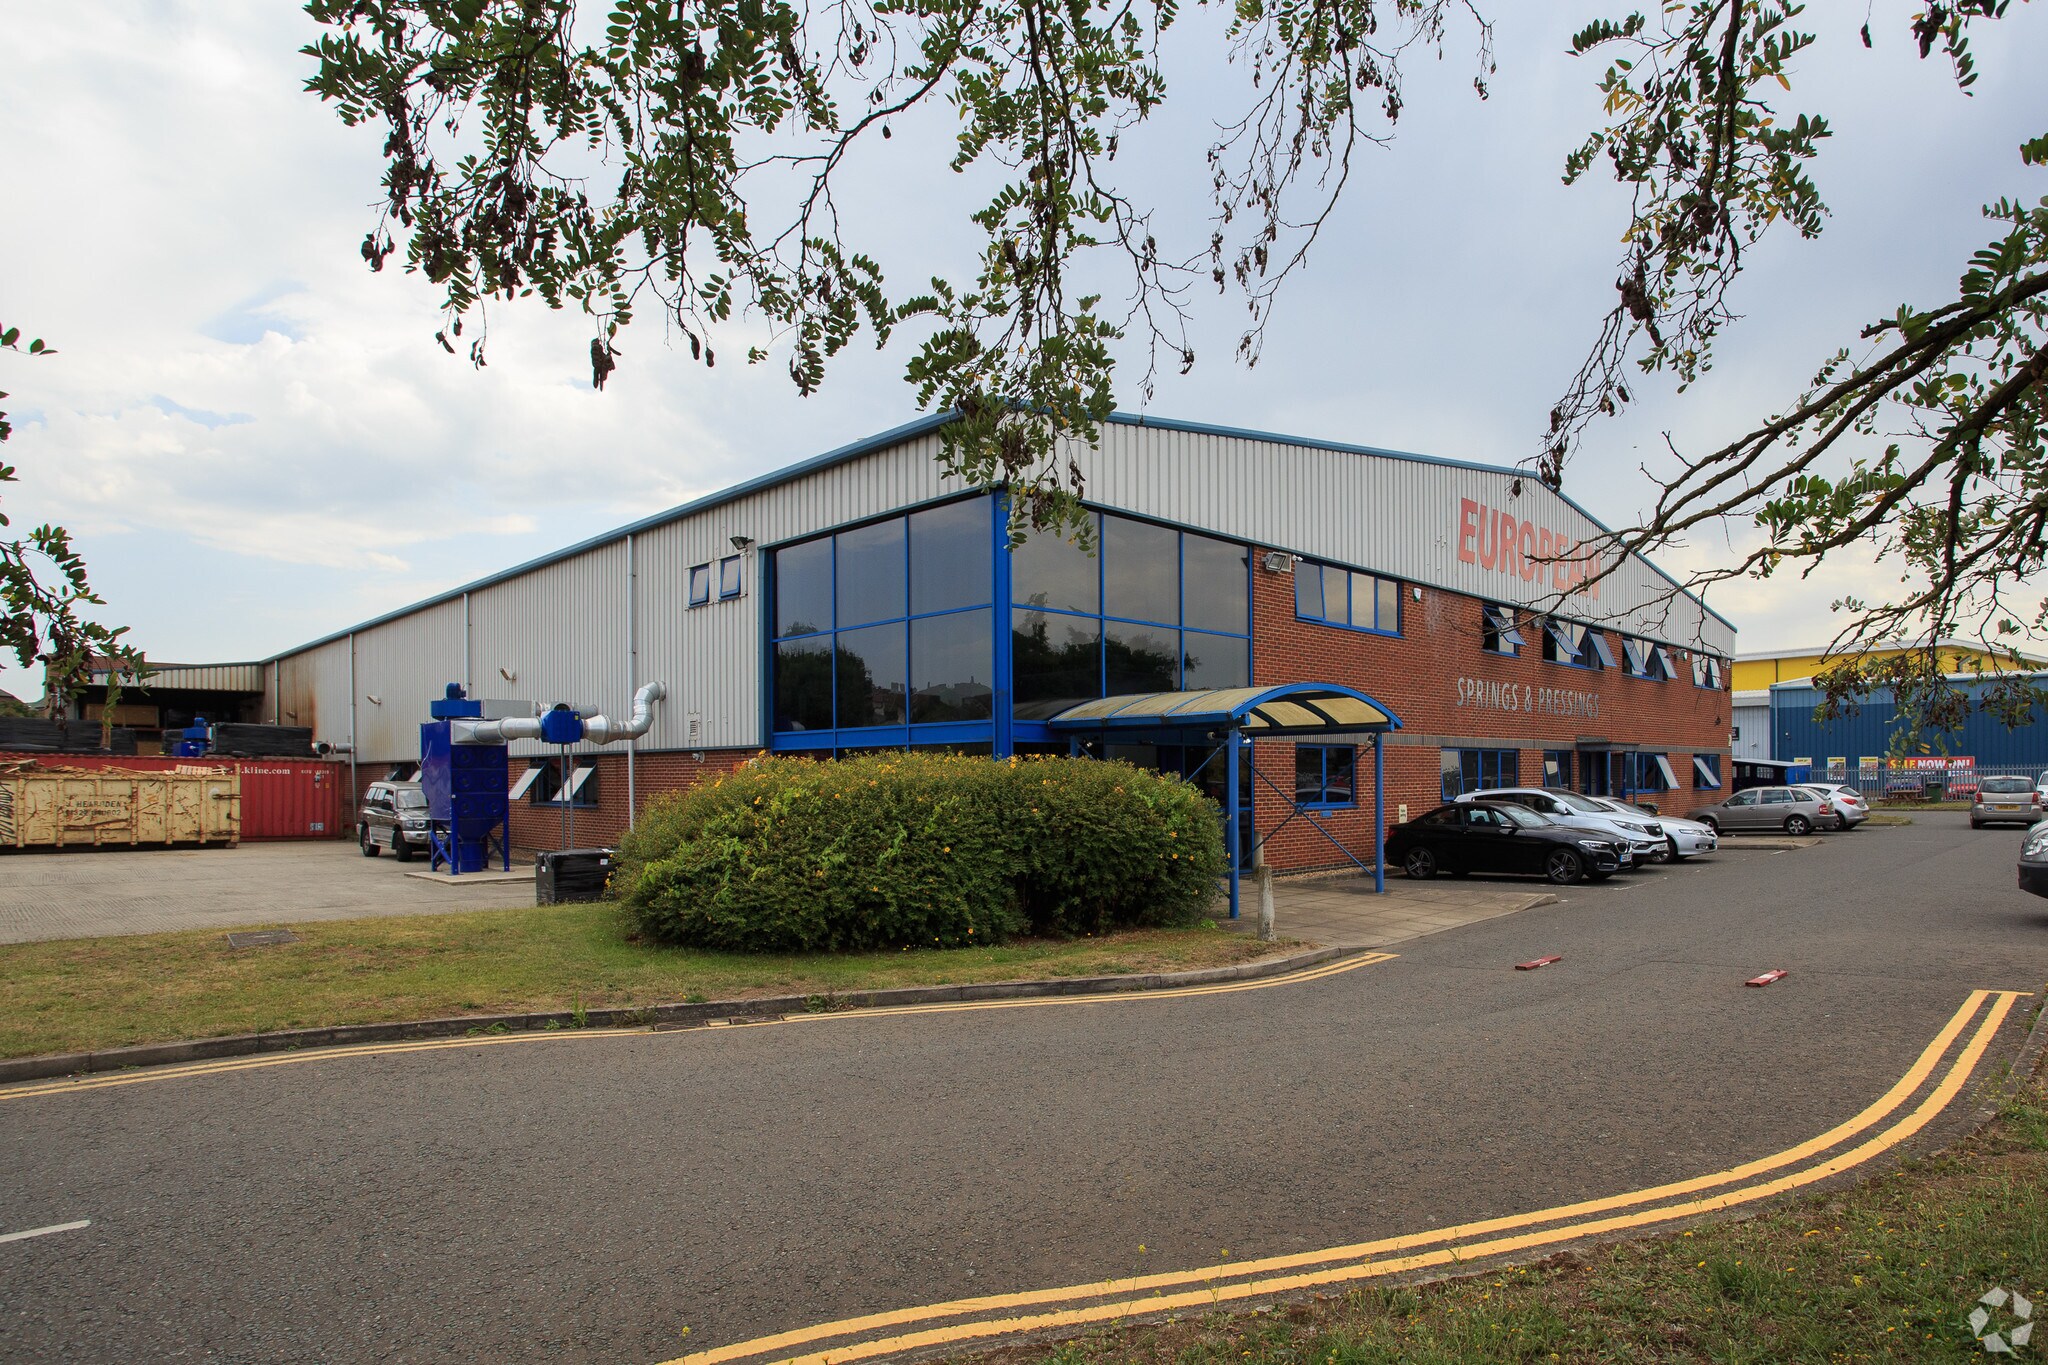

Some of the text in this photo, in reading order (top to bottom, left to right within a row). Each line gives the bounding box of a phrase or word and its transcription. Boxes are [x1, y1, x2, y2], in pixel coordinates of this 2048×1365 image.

[1459, 497, 1600, 601] EUROPEAN
[1457, 677, 1599, 718] SPRINGS & PRESSINGS
[1889, 759, 1916, 769] SLE
[1917, 759, 1946, 769] NOW
